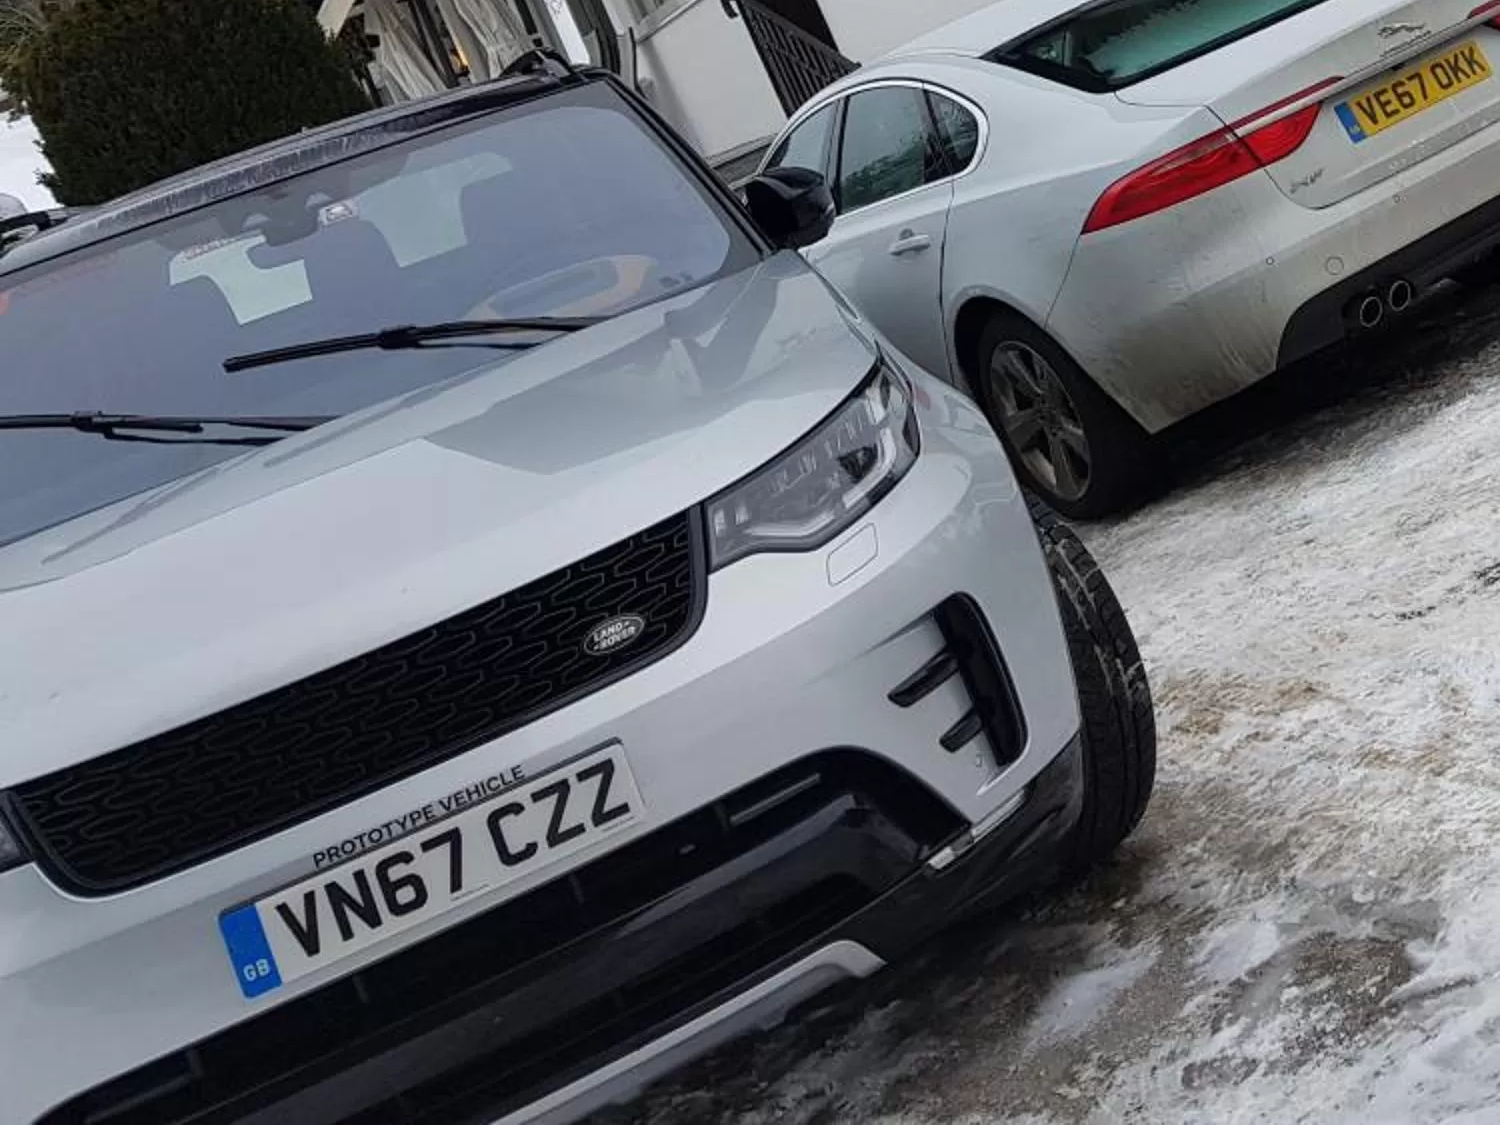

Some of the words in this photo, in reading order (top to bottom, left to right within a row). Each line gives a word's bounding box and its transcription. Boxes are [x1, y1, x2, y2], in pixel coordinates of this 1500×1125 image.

[1356, 76, 1429, 127] VE67
[1428, 46, 1486, 91] OKK
[275, 826, 463, 959] VN67
[486, 758, 632, 867] CZZ
[312, 803, 435, 871] PROTOTYPE
[439, 764, 529, 814] VEHICLE
[242, 958, 272, 983] GB
